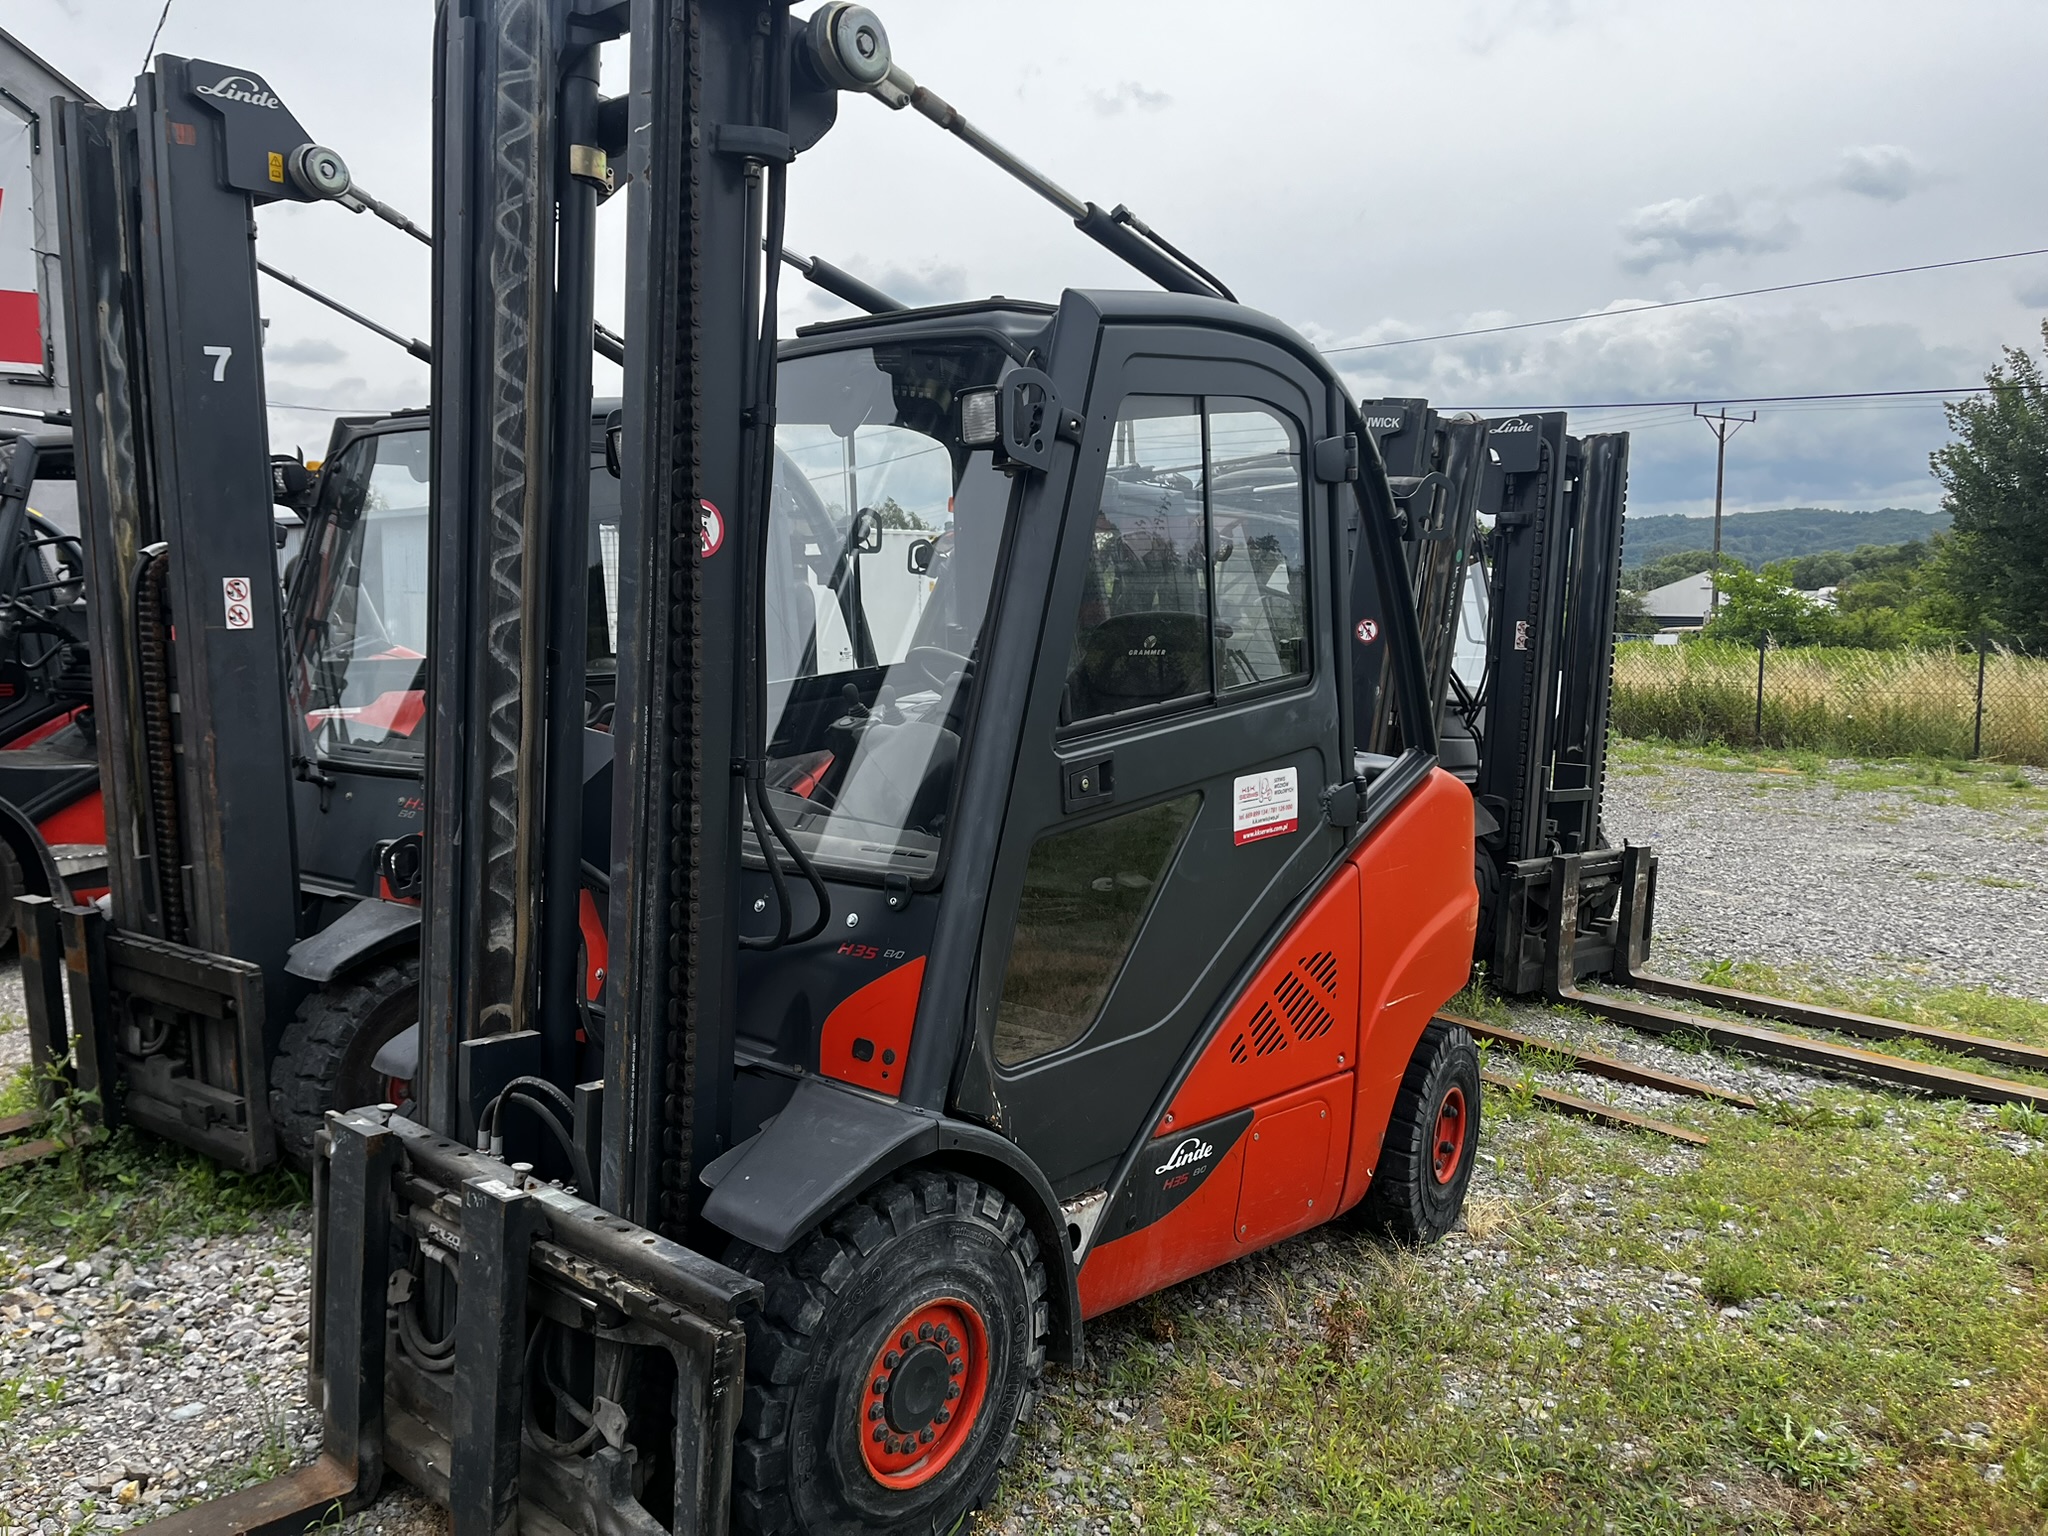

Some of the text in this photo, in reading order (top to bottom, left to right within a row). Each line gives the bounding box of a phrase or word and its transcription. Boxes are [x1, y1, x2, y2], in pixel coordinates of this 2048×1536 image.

[196, 76, 279, 109] Linde
[203, 345, 232, 382] 7
[1367, 415, 1400, 429] WICK
[1489, 418, 1534, 434] Linde
[837, 943, 905, 959] H35 EVO
[1155, 1137, 1213, 1175] Linde
[1163, 1165, 1207, 1191] H35 EVO
